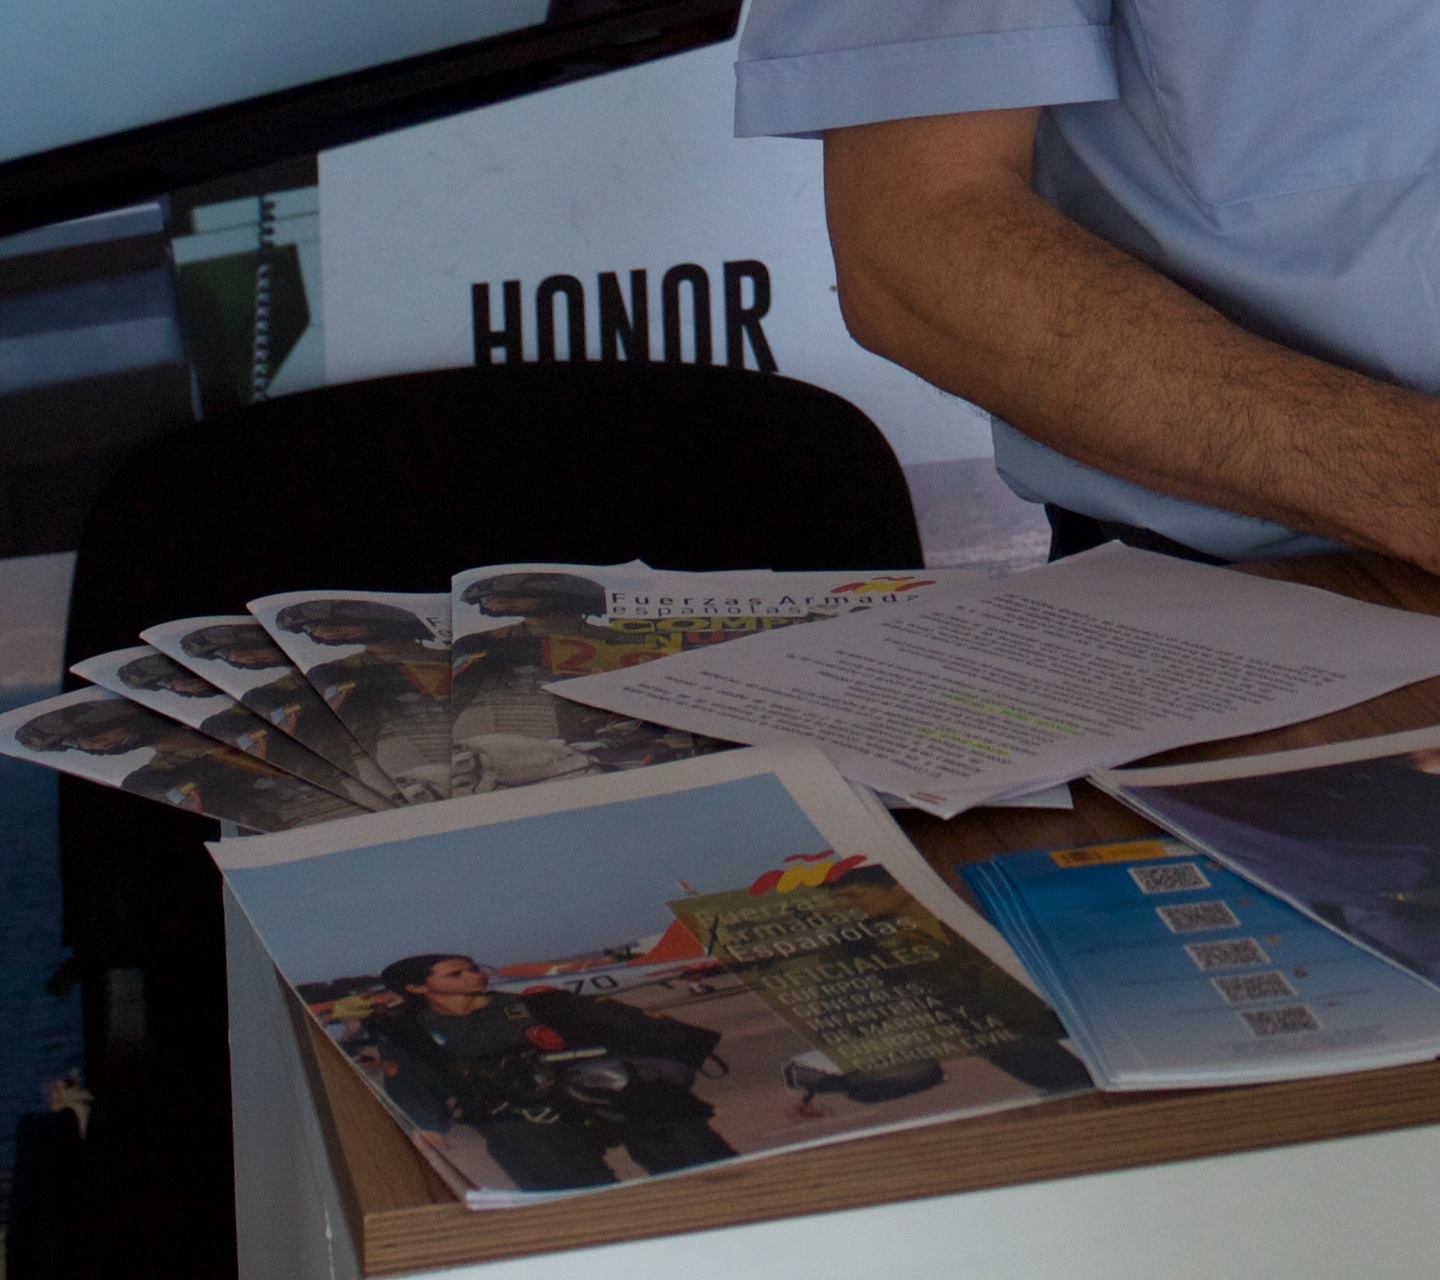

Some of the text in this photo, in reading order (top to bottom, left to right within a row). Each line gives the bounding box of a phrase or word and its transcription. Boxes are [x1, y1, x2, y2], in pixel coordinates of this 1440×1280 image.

[471, 259, 779, 372] HONOR
[612, 592, 762, 606] Fuerzas
[761, 943, 941, 992] OFICIALES
[777, 974, 886, 1007] CUERPOS
